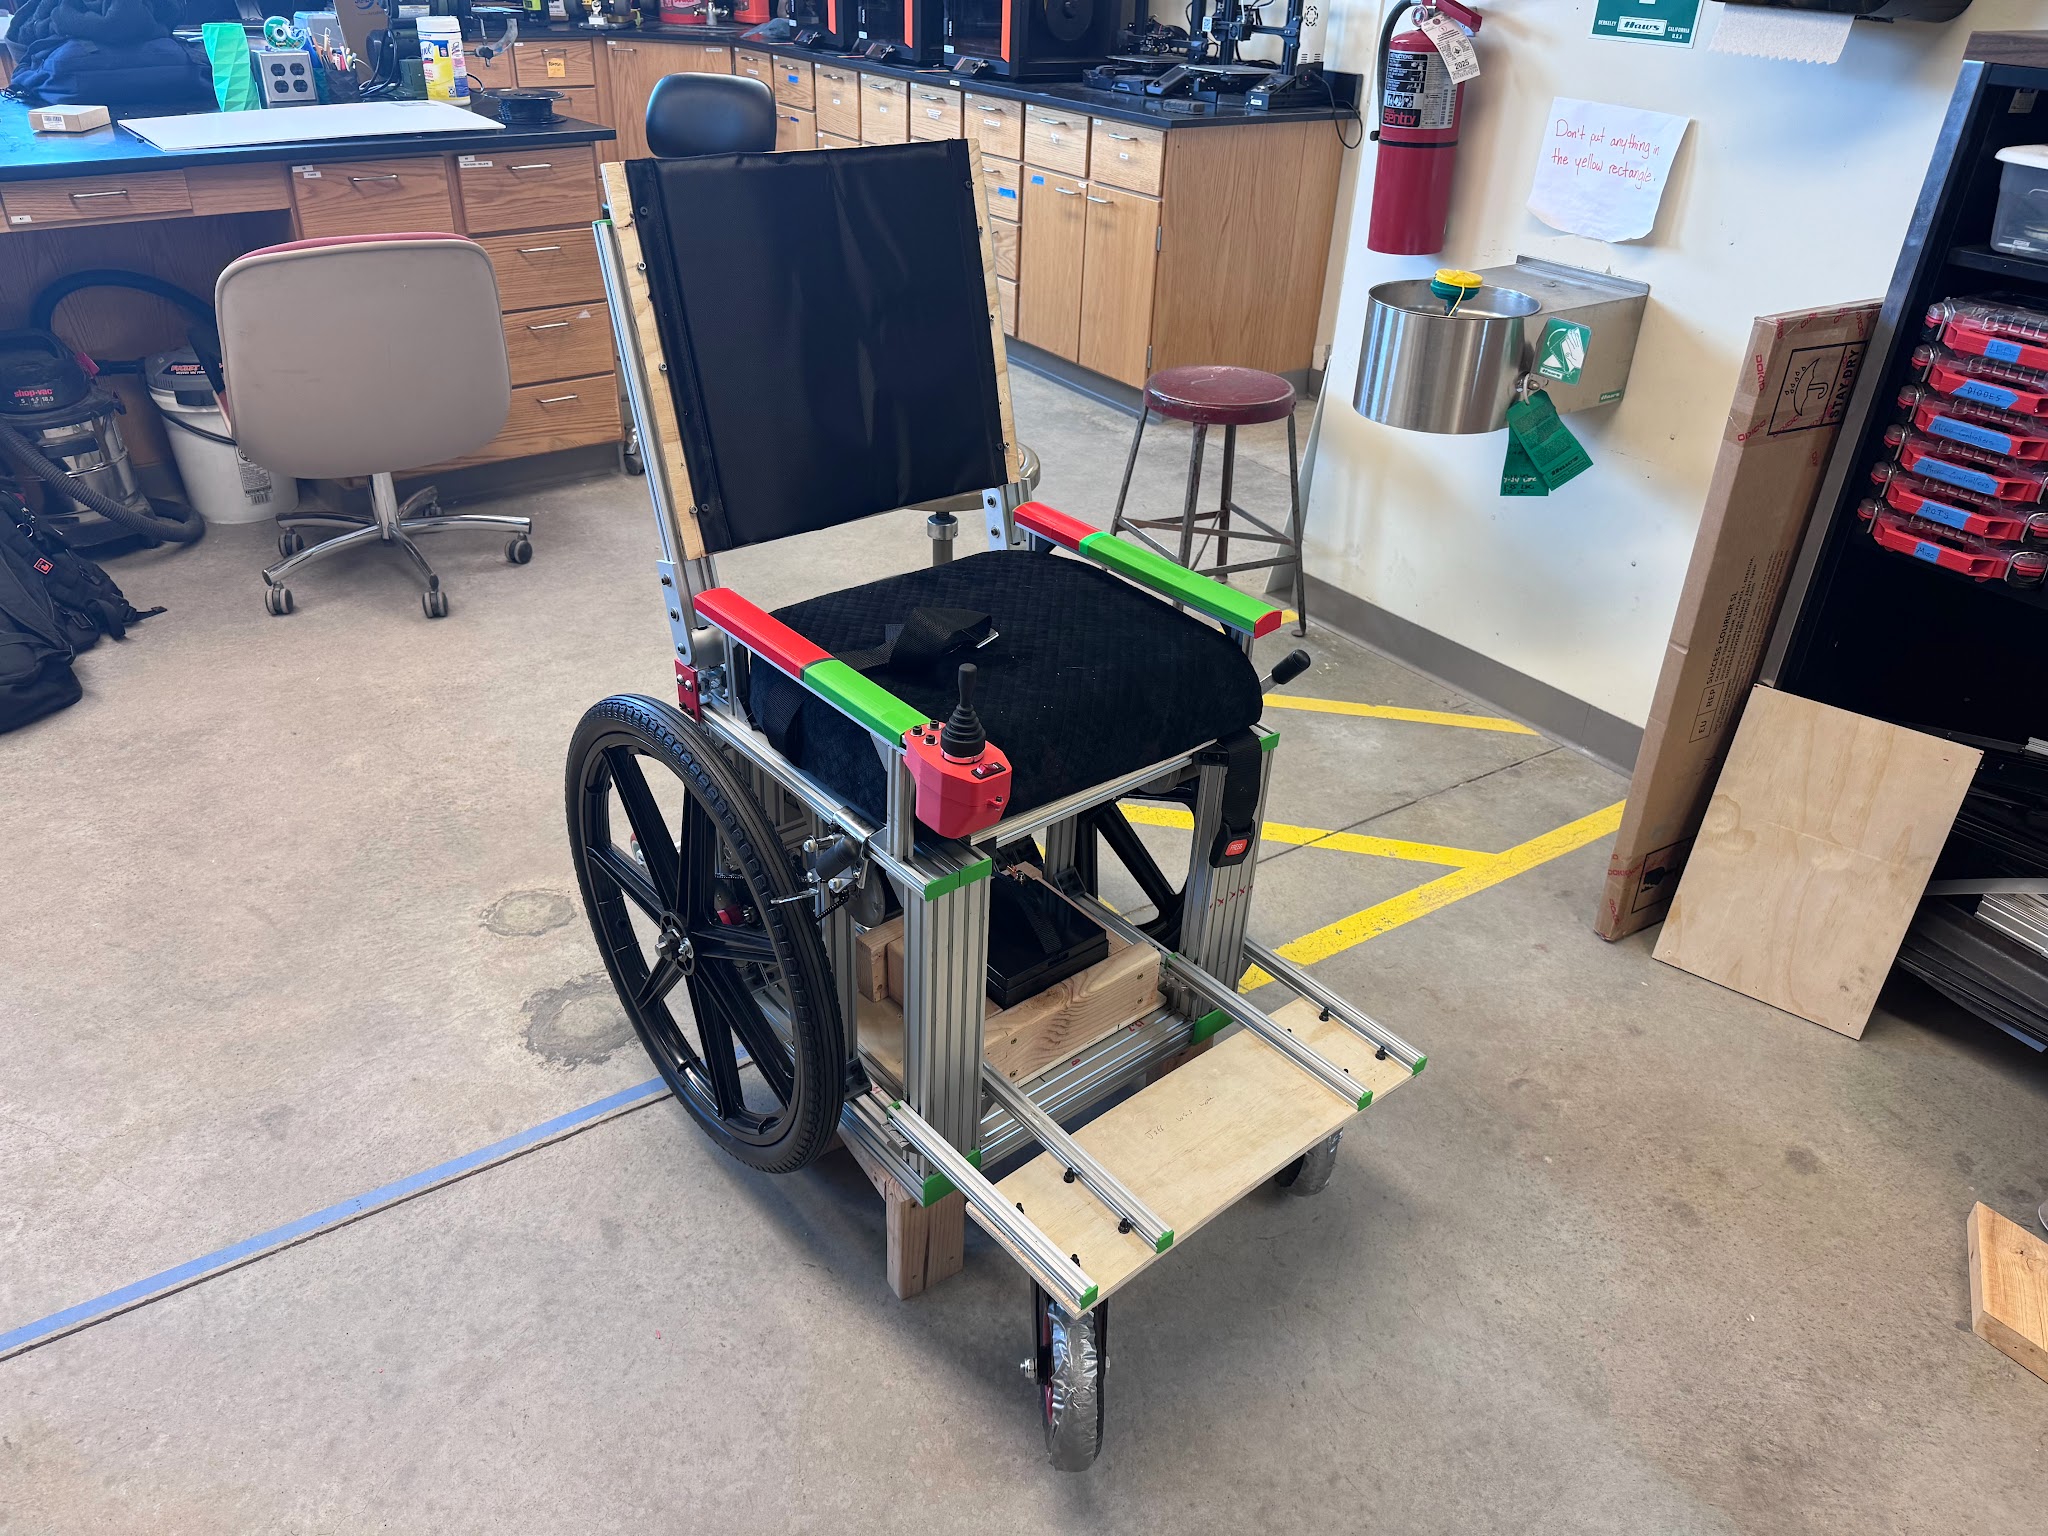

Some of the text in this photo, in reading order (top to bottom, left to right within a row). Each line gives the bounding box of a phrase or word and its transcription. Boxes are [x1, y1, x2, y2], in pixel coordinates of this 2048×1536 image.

[1624, 21, 1660, 31] Haws
[1667, 26, 1690, 34] CALIFORNIA
[1454, 59, 1470, 70] 2025
[1383, 111, 1417, 126] sentry
[1556, 119, 1660, 159] Don't put anything in
[1552, 148, 1656, 189] the yellow rectangle.
[1829, 349, 1860, 418] STAY DRY
[1967, 386, 2002, 402] DIODES
[1925, 506, 1949, 520] POTS
[1706, 590, 1739, 685] SUCCESS COURIER SL
[1698, 688, 1717, 734] EU REP
[1230, 843, 1243, 851] PRESS
